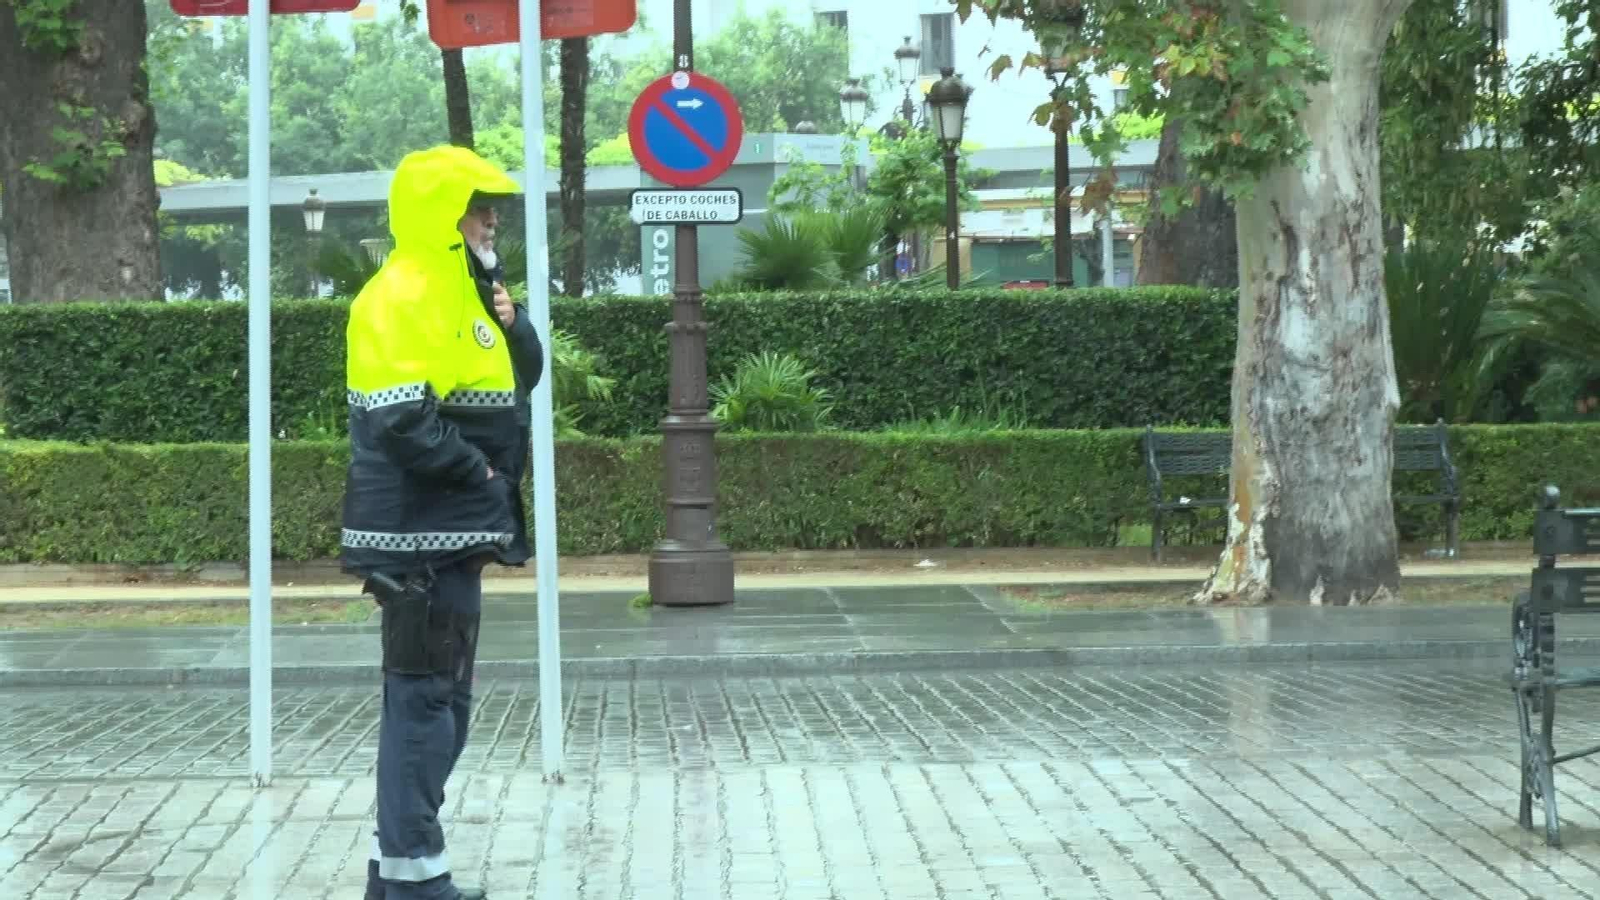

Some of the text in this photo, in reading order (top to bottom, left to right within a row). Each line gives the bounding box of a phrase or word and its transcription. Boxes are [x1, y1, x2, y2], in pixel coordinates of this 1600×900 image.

[635, 195, 737, 205] EXCEPTO COCHES
[647, 210, 718, 220] DE CABALLO
[650, 229, 670, 295] etro
